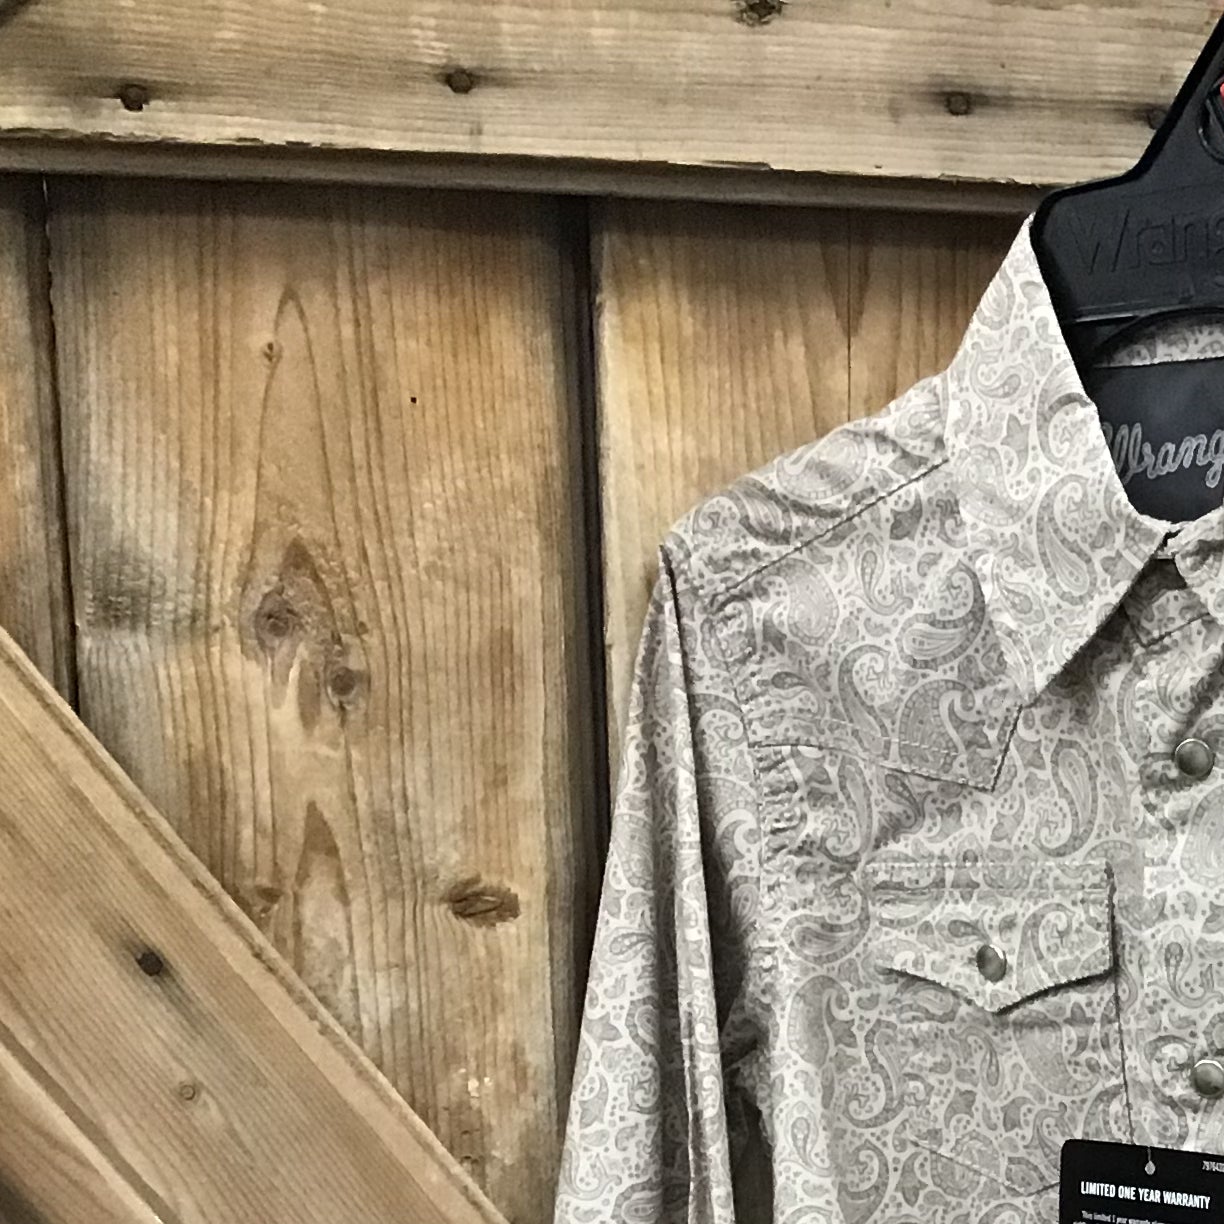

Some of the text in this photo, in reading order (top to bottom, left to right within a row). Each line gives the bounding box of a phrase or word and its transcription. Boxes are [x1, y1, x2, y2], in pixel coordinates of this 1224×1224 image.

[1080, 1181, 1211, 1210] LIMITED ONE YEAR WARRANTY
